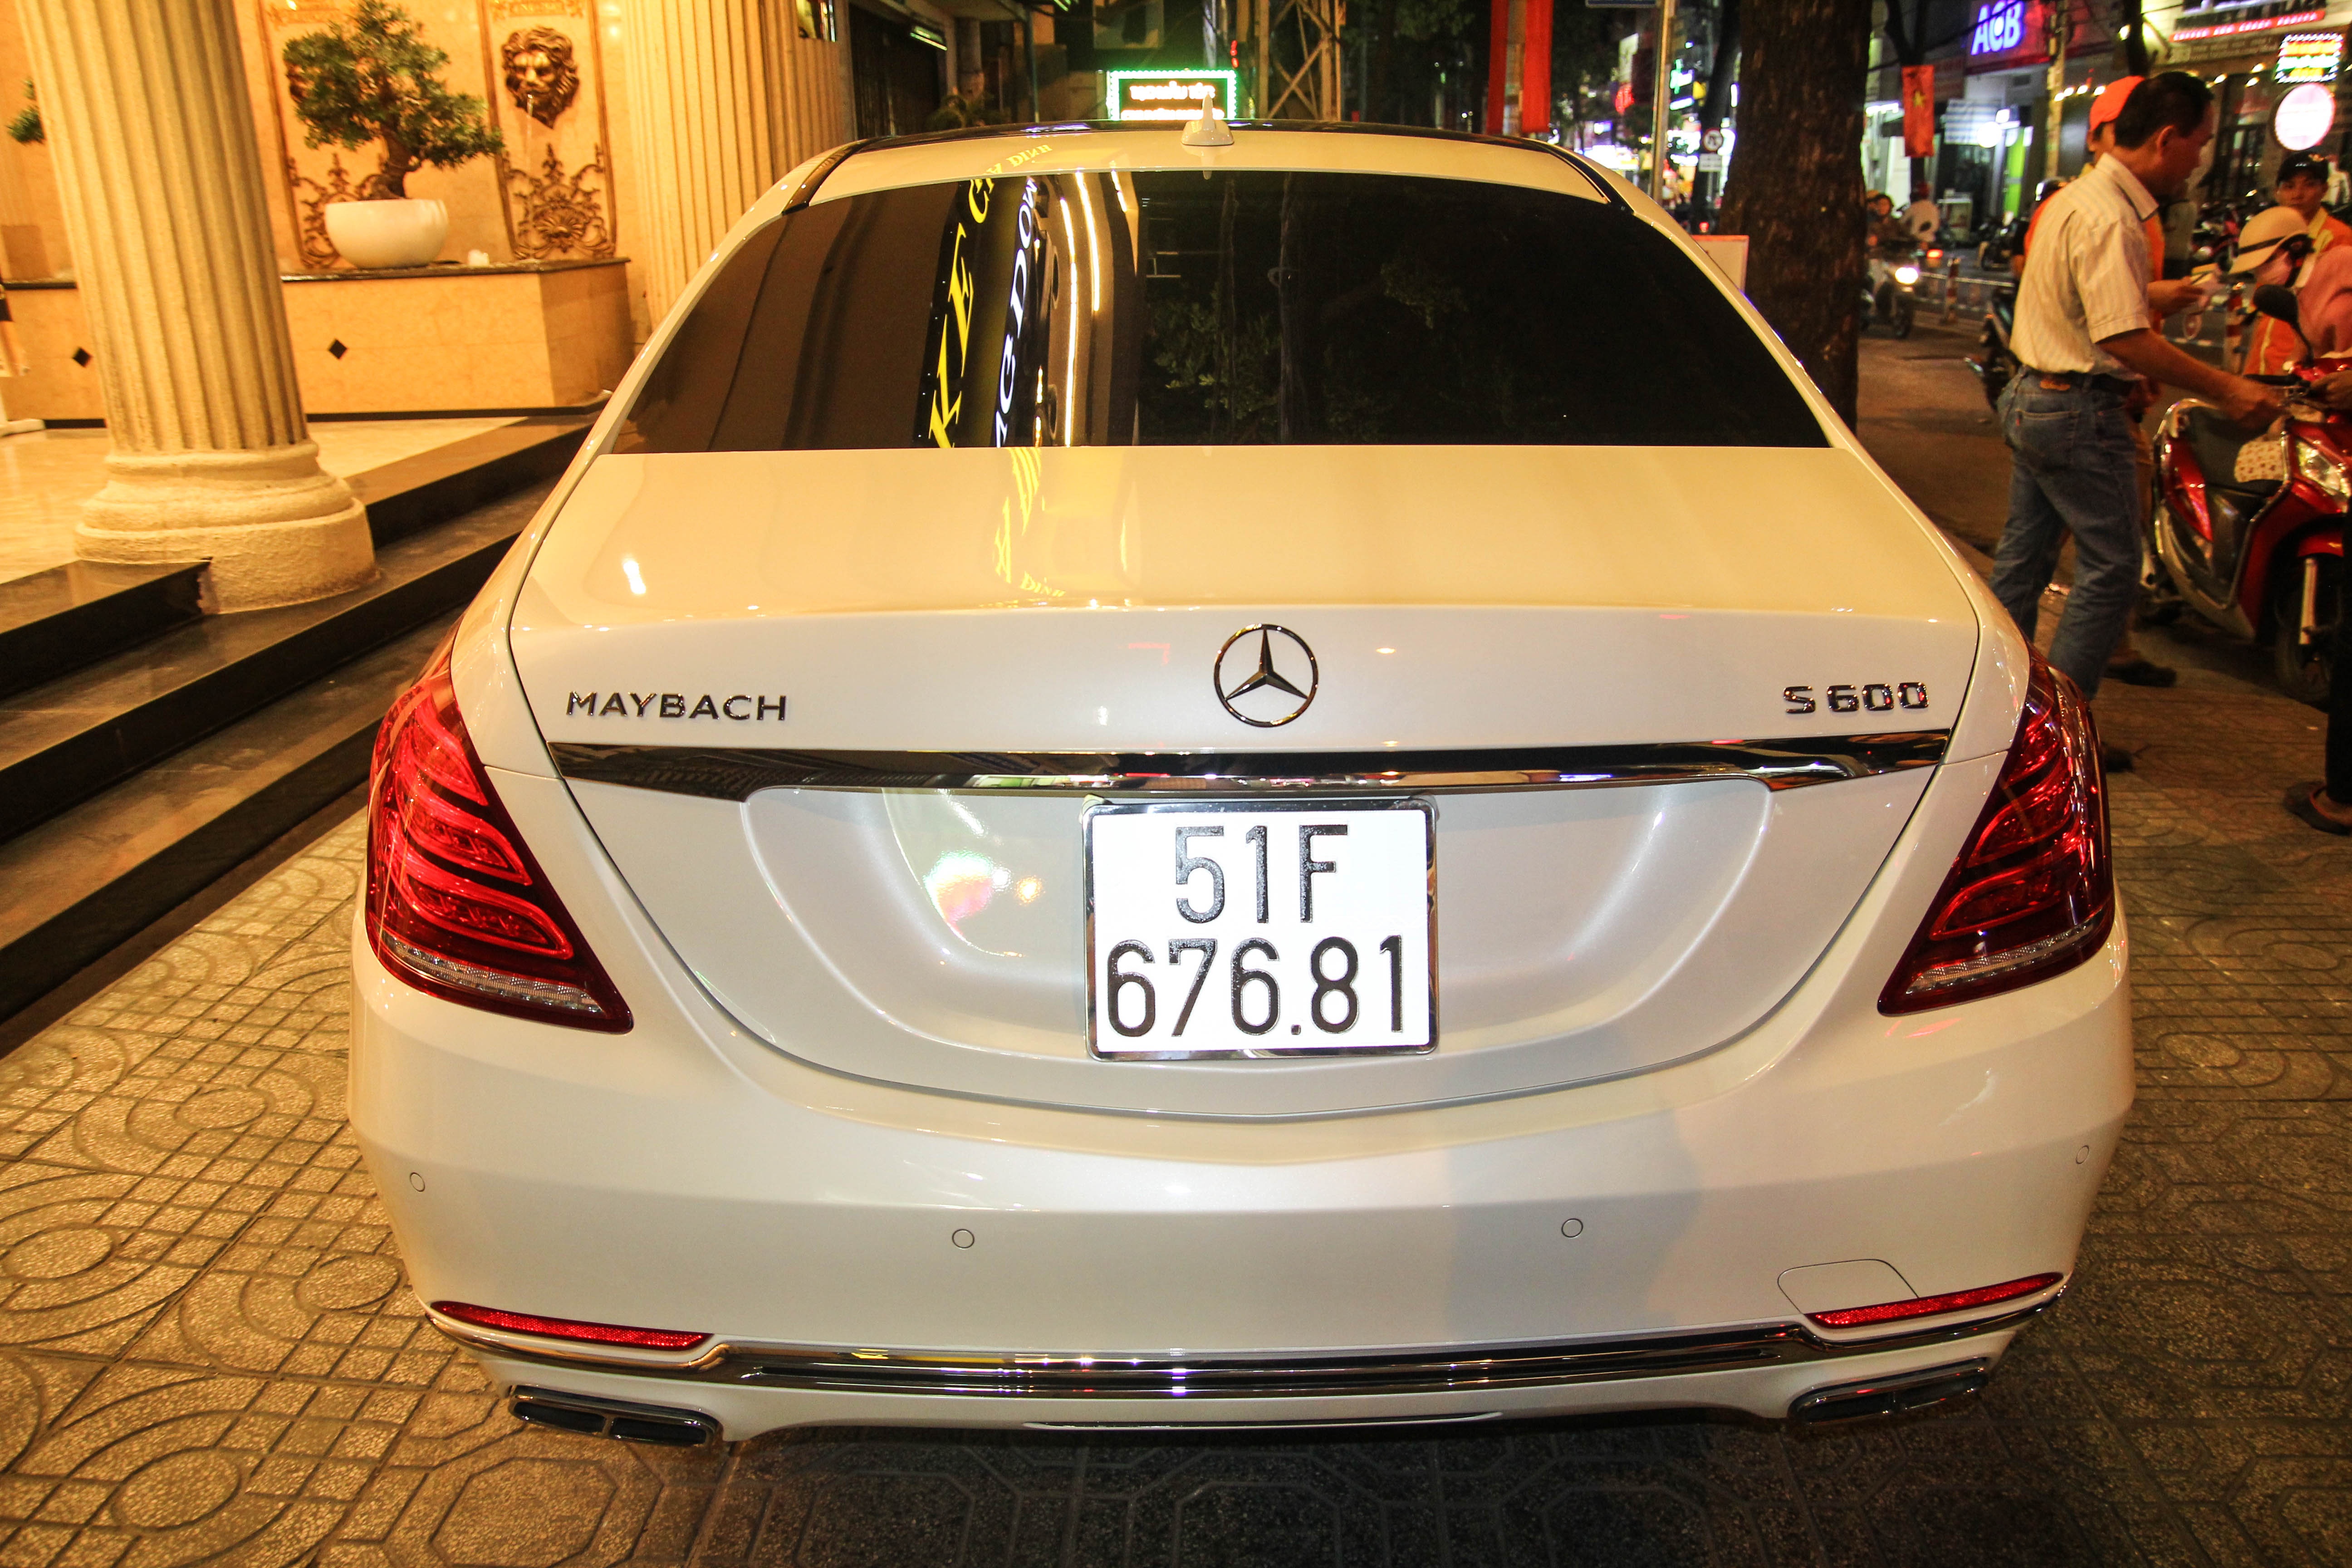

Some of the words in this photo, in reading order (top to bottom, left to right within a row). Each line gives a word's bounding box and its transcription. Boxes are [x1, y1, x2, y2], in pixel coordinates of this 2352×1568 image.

[1970, 0, 2024, 55] ACB
[566, 691, 787, 721] MAYBACH
[1783, 686, 1816, 714] S
[1827, 682, 1930, 712] 600
[1175, 824, 1348, 924] 51F
[1107, 935, 1403, 1038] 676.81
